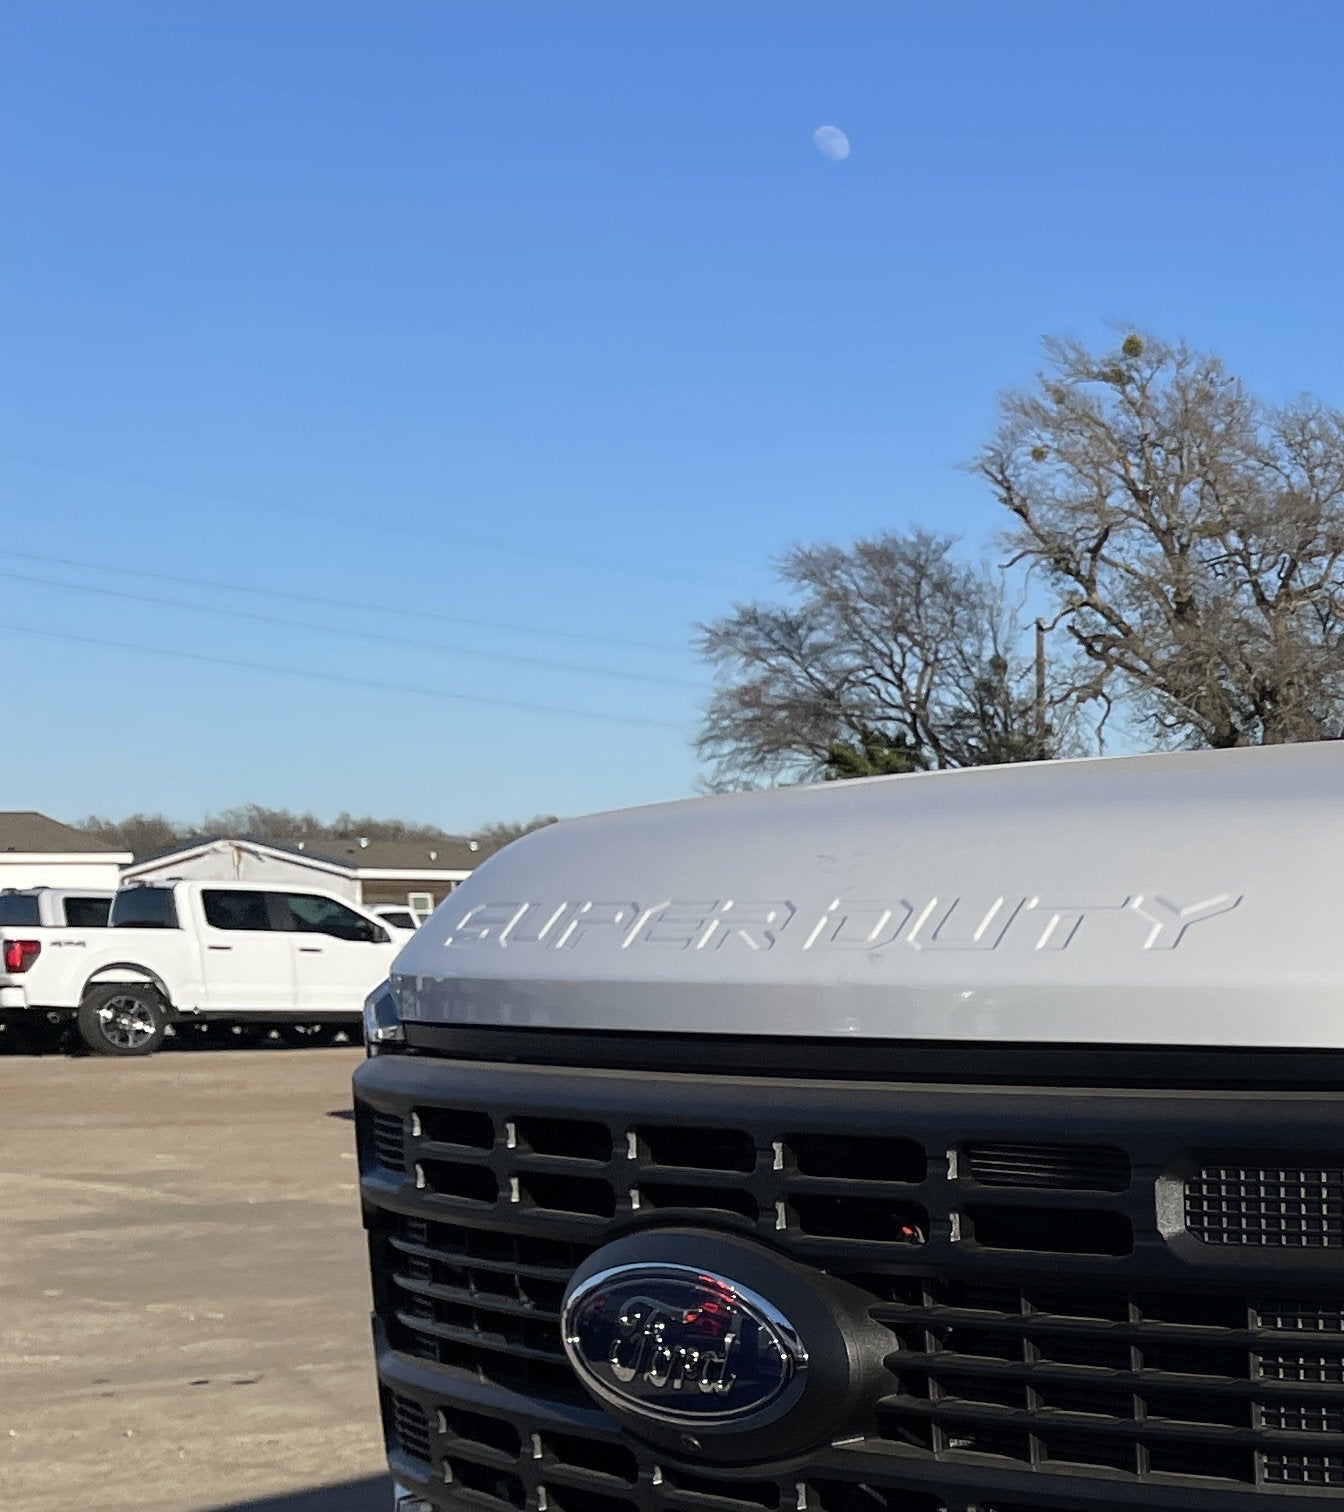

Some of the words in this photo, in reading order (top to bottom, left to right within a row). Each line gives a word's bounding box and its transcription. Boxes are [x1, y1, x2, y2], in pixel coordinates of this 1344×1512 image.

[443, 898, 797, 950] SUPER
[804, 895, 1244, 951] DUTY
[610, 1294, 737, 1396] Ford
